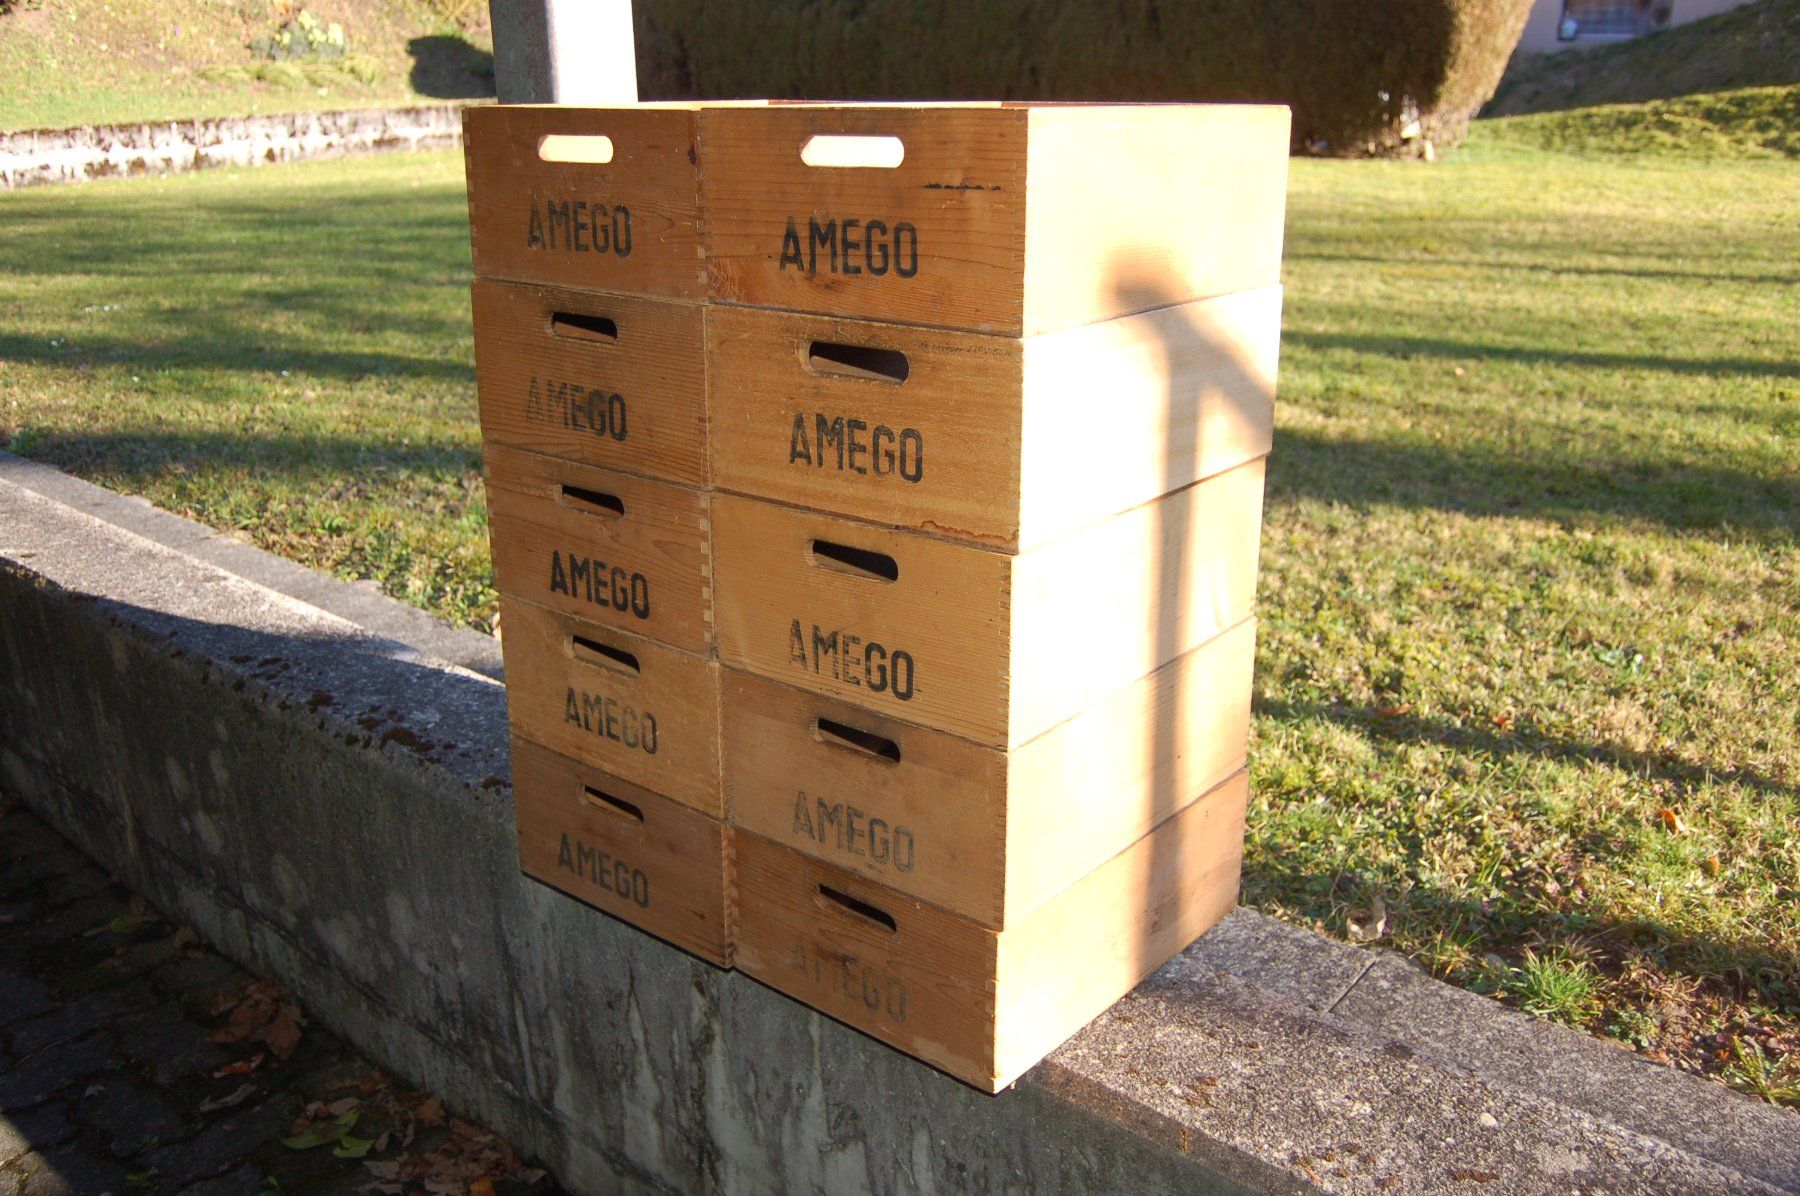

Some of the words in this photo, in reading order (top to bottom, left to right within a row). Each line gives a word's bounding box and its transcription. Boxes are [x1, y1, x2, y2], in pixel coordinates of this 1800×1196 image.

[528, 194, 632, 257] AMEGO
[779, 215, 919, 279] AMEGO
[527, 376, 628, 442] AMEGO
[789, 411, 924, 484] AMEGO
[551, 550, 650, 620] AMEGO
[789, 617, 915, 701] AMEGO
[565, 686, 659, 755] AMEGO
[792, 790, 915, 873] AMEGO
[558, 832, 649, 908] AMEGO
